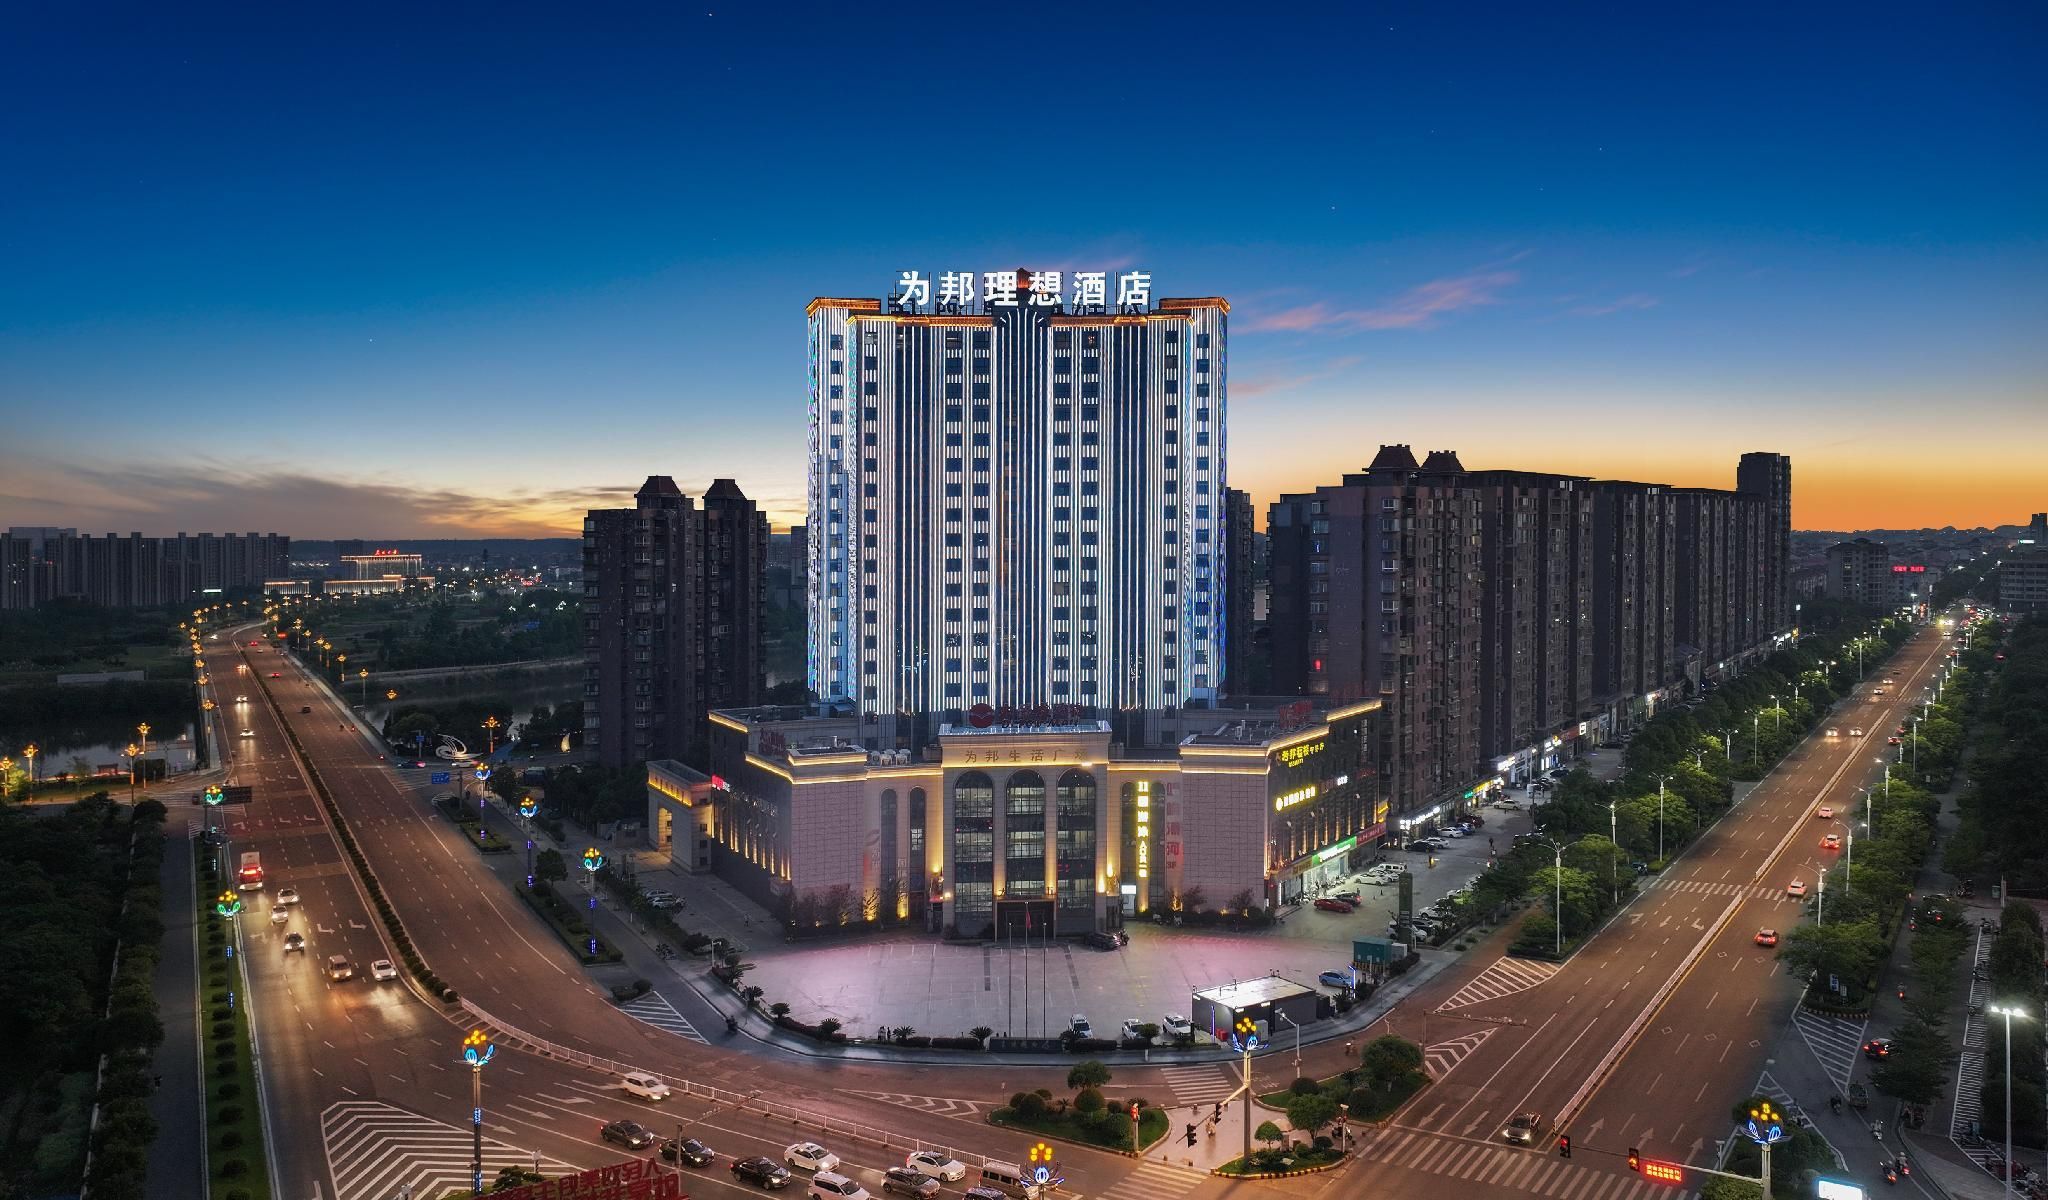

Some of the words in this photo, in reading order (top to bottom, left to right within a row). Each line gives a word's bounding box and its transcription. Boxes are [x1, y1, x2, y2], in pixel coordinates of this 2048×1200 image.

[898, 271, 1151, 306] 为邦理想酒店
[965, 749, 1089, 763] 为邦生活广场
